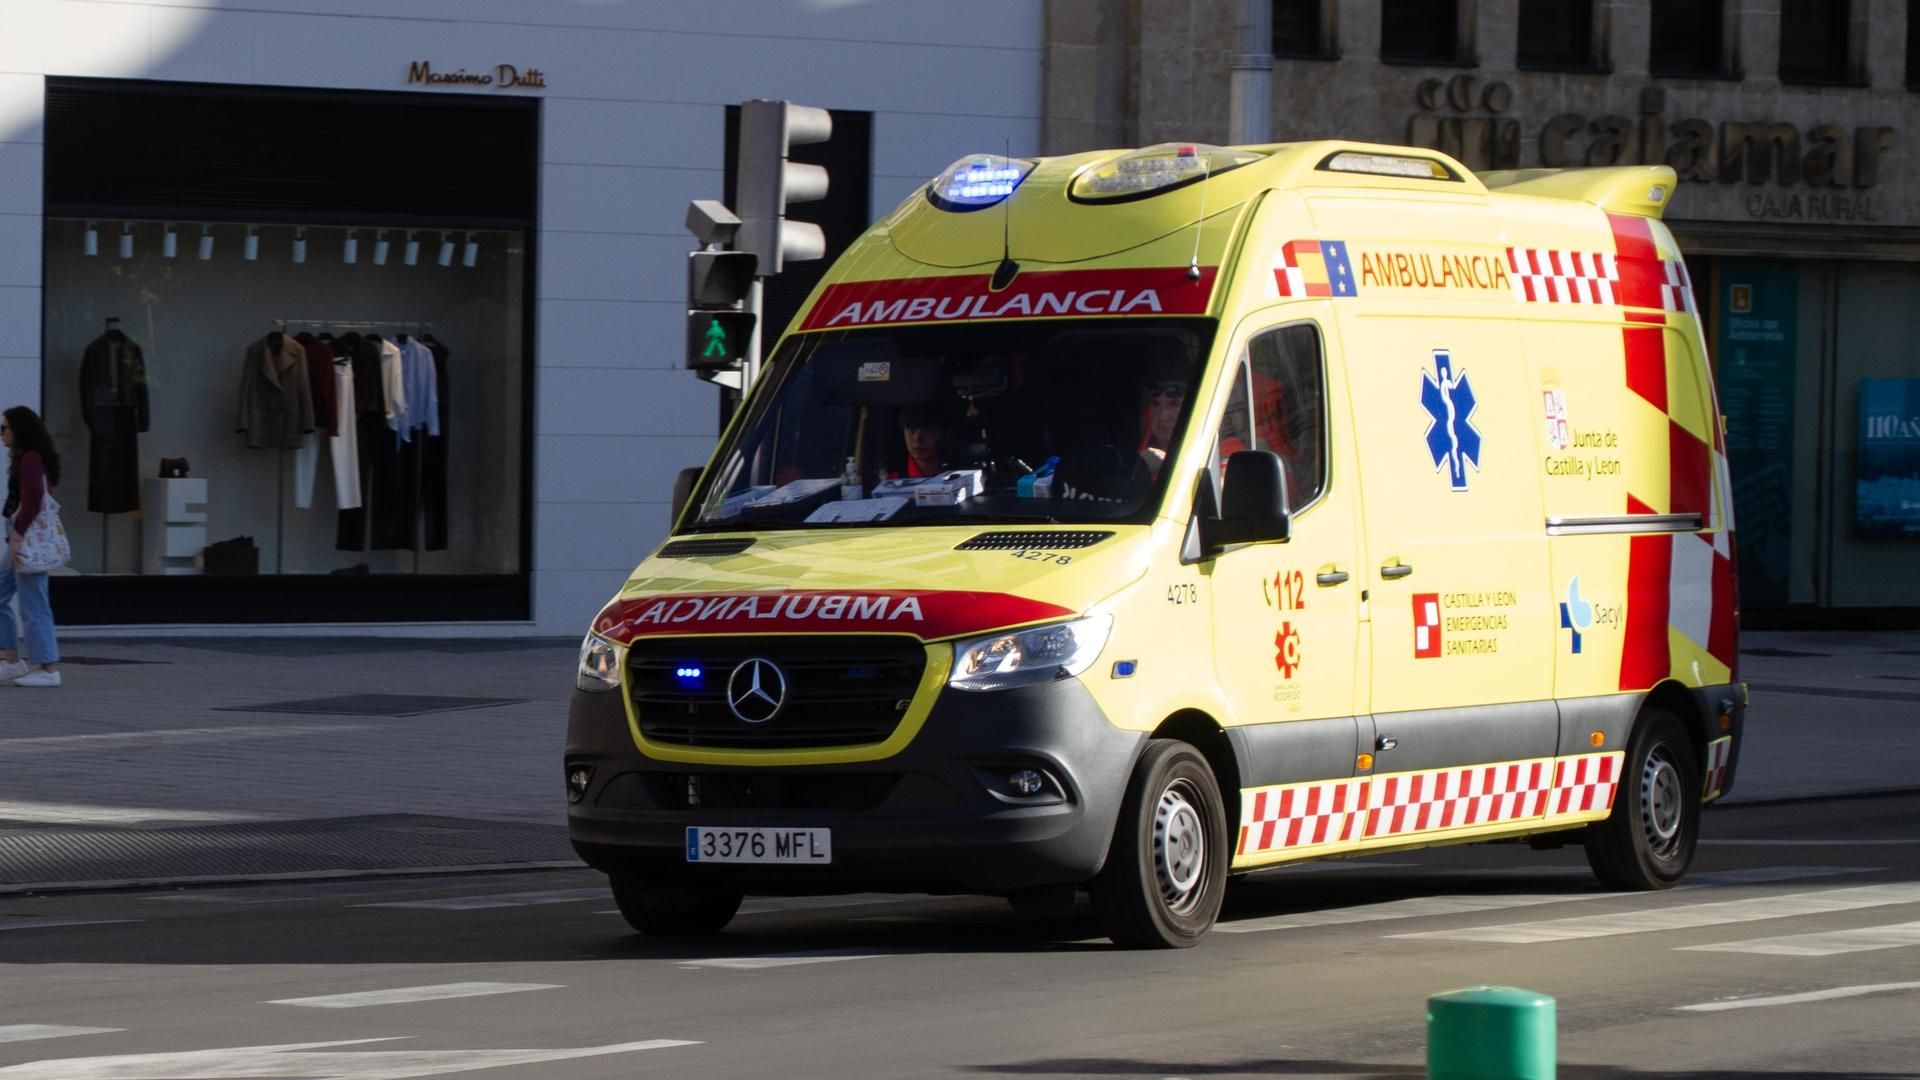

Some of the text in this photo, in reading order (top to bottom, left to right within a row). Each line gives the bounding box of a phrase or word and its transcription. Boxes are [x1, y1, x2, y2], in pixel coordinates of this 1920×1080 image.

[497, 64, 546, 88] Dutti
[1540, 87, 1896, 189] cajamar
[1747, 193, 1880, 221] CAJA RURAL
[1361, 251, 1511, 289] AMBULANCIA
[826, 288, 1163, 326] AMBULANCIA
[1573, 428, 1618, 448] Junta de
[1545, 456, 1584, 476] Castilla
[1586, 459, 1593, 481] y
[1010, 549, 1072, 566] 4278
[1167, 583, 1198, 605] 4278
[1274, 570, 1305, 611] 112
[1443, 592, 1484, 608] CASTILLA
[1485, 592, 1492, 607] Y
[1446, 615, 1508, 632] EMERGENCIAS
[1595, 602, 1623, 630] Sacyl
[1446, 639, 1498, 656] SANITARIAS
[703, 832, 765, 858] 3376
[775, 831, 825, 858] MFL
